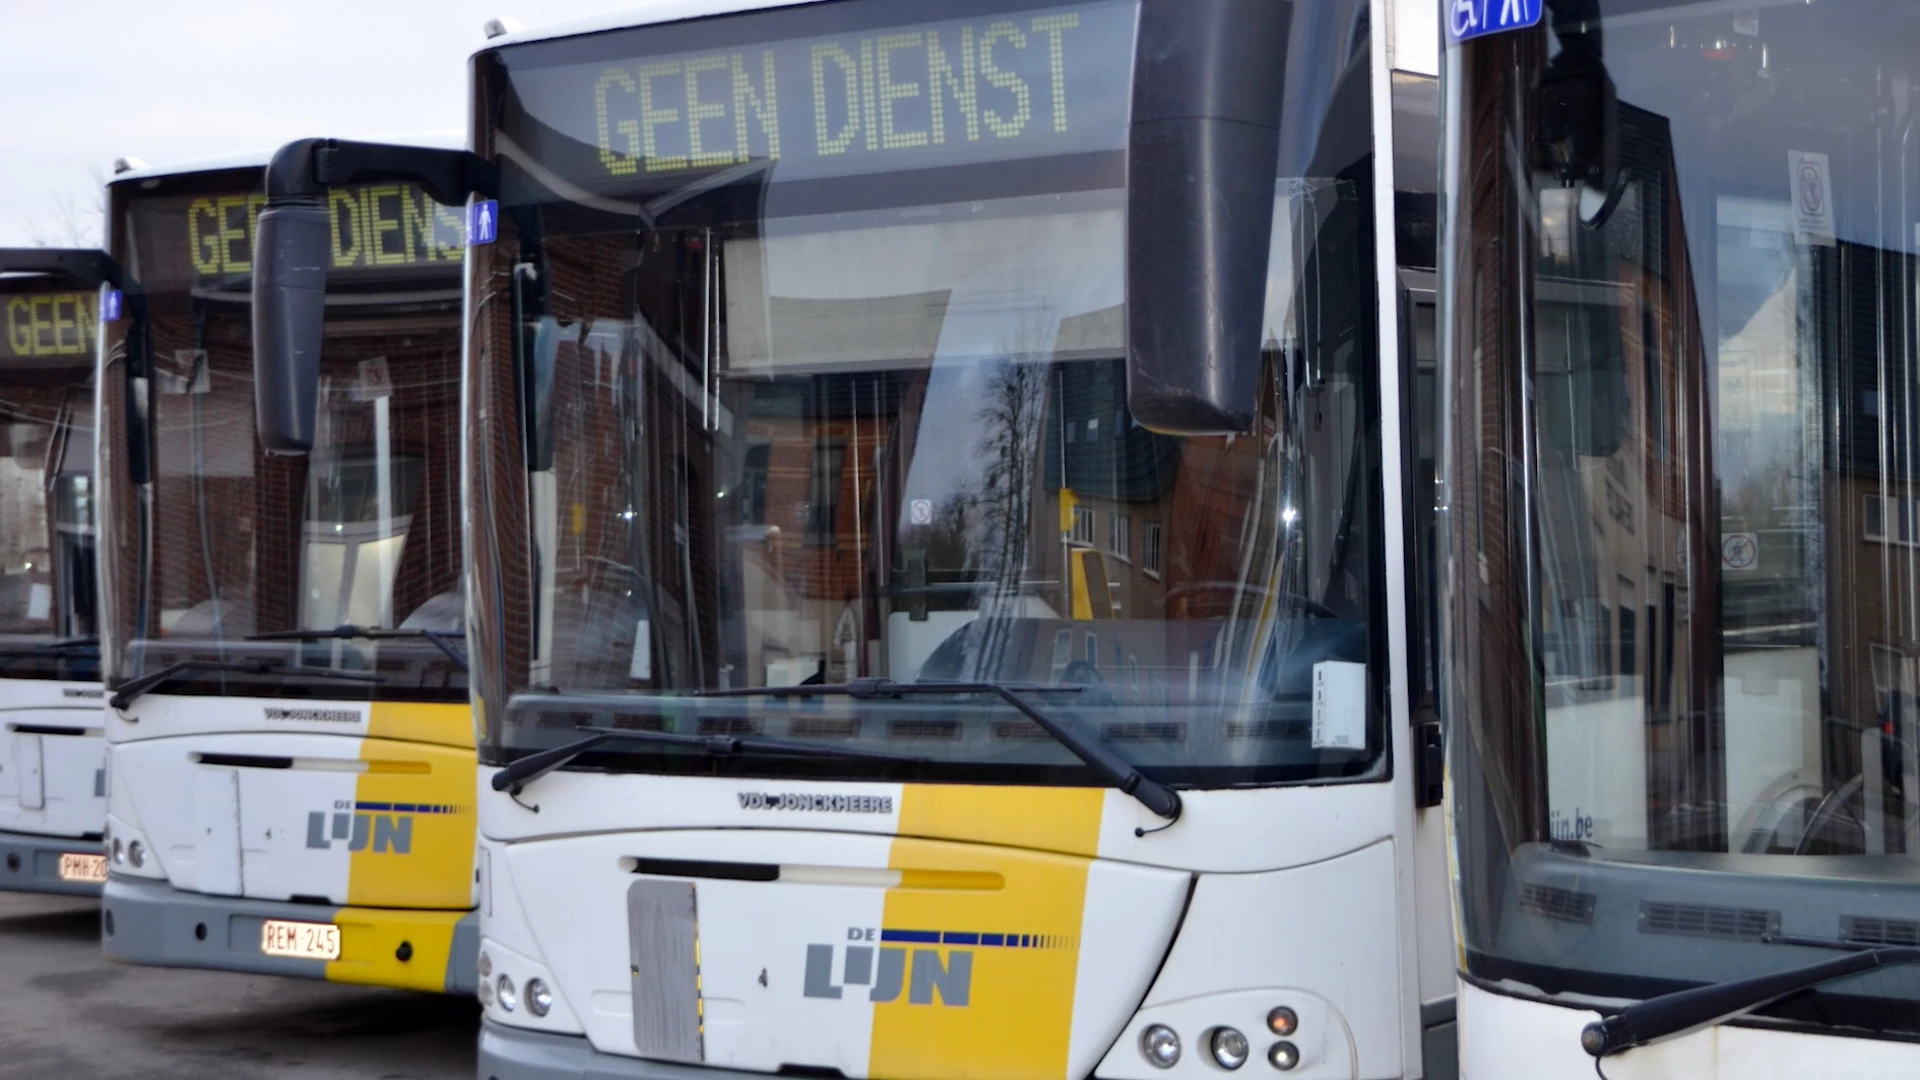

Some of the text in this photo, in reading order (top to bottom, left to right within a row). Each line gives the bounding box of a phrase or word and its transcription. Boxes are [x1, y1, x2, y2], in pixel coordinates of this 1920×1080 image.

[594, 13, 1080, 175] GEEN DIENST
[7, 294, 99, 356] GEEN
[333, 798, 353, 810] DE
[737, 791, 893, 814] VDL JONCKHEERE
[305, 810, 415, 855] LIJN
[846, 926, 877, 942] DE
[803, 943, 974, 1008] LIJN
